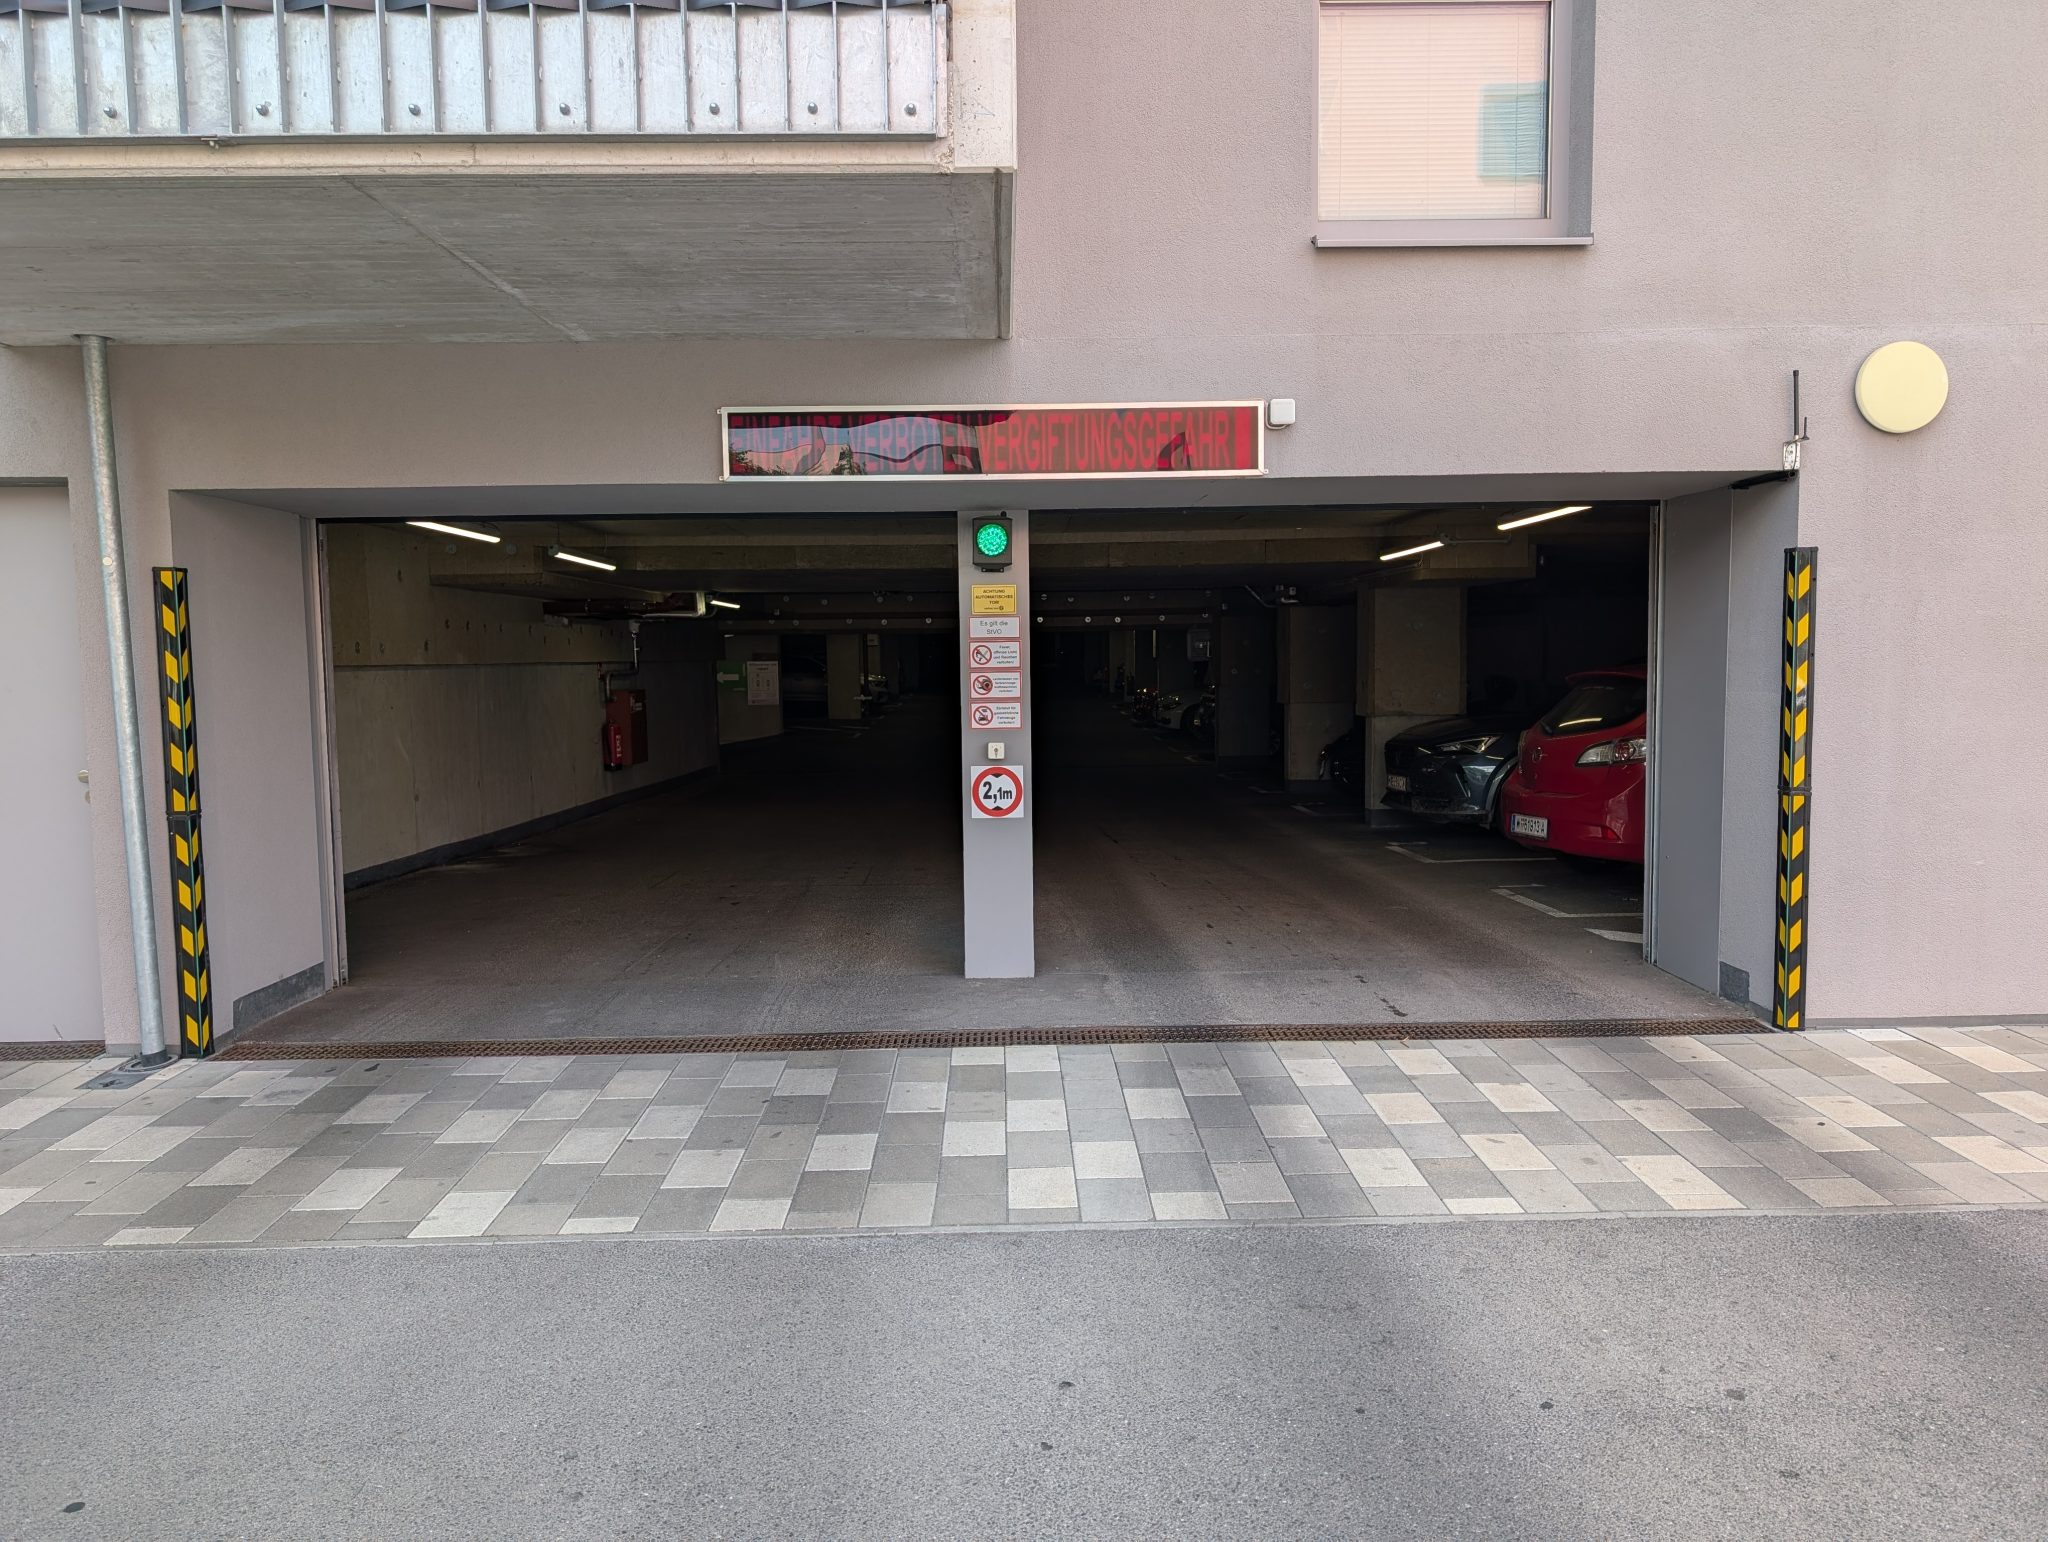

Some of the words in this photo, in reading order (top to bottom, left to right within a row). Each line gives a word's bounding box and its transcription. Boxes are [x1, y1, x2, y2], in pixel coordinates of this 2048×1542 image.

[731, 414, 843, 474] EINFAHRT
[847, 413, 974, 474] VERBOTEN
[977, 411, 1231, 474] VERGIFTUNGSGEFAHR
[989, 620, 998, 628] gilt
[983, 781, 1012, 804] 2,1m
